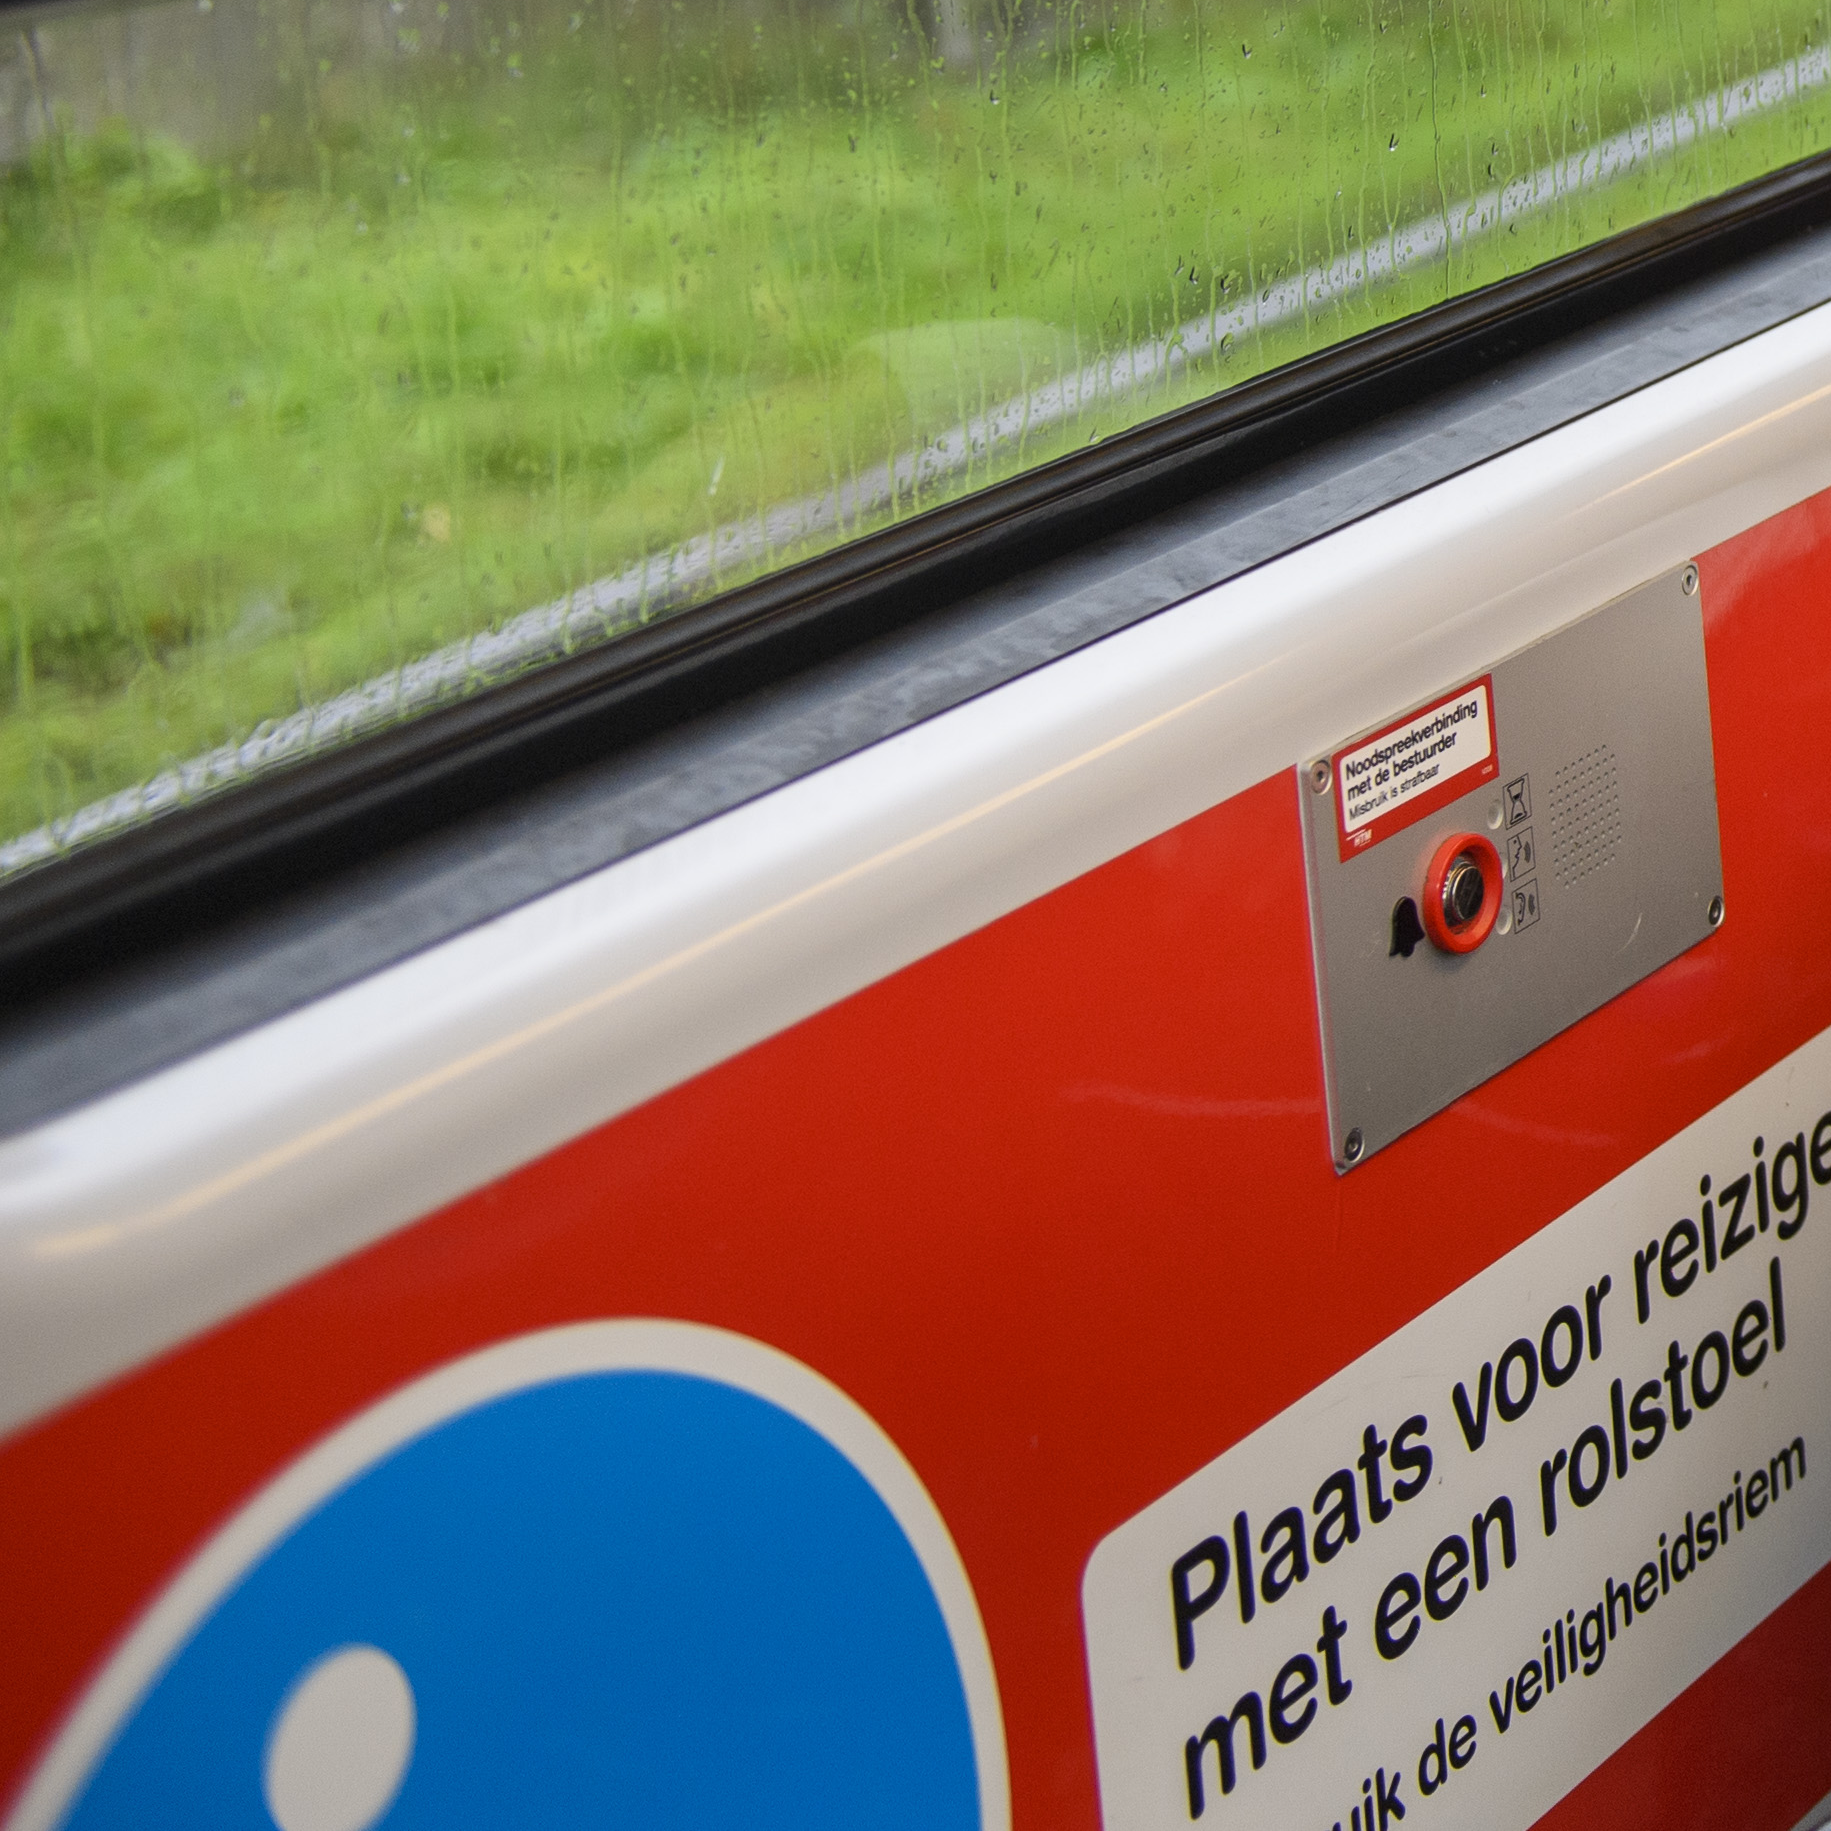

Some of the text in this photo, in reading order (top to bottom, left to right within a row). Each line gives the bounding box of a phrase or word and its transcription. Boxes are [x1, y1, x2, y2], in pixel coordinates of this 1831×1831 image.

[1345, 700, 1478, 780] Noodspreekverbinding
[1347, 732, 1457, 801] met de bestuurder
[1349, 763, 1440, 820] Misbruik is strafbaar
[1171, 1414, 1433, 1671] Plaats
[1452, 1274, 1612, 1452] voor
[1185, 1256, 1786, 1820] met een rolstoel
[1418, 1714, 1477, 1796] de
[1489, 1436, 1807, 1734] veiligheidsriem
